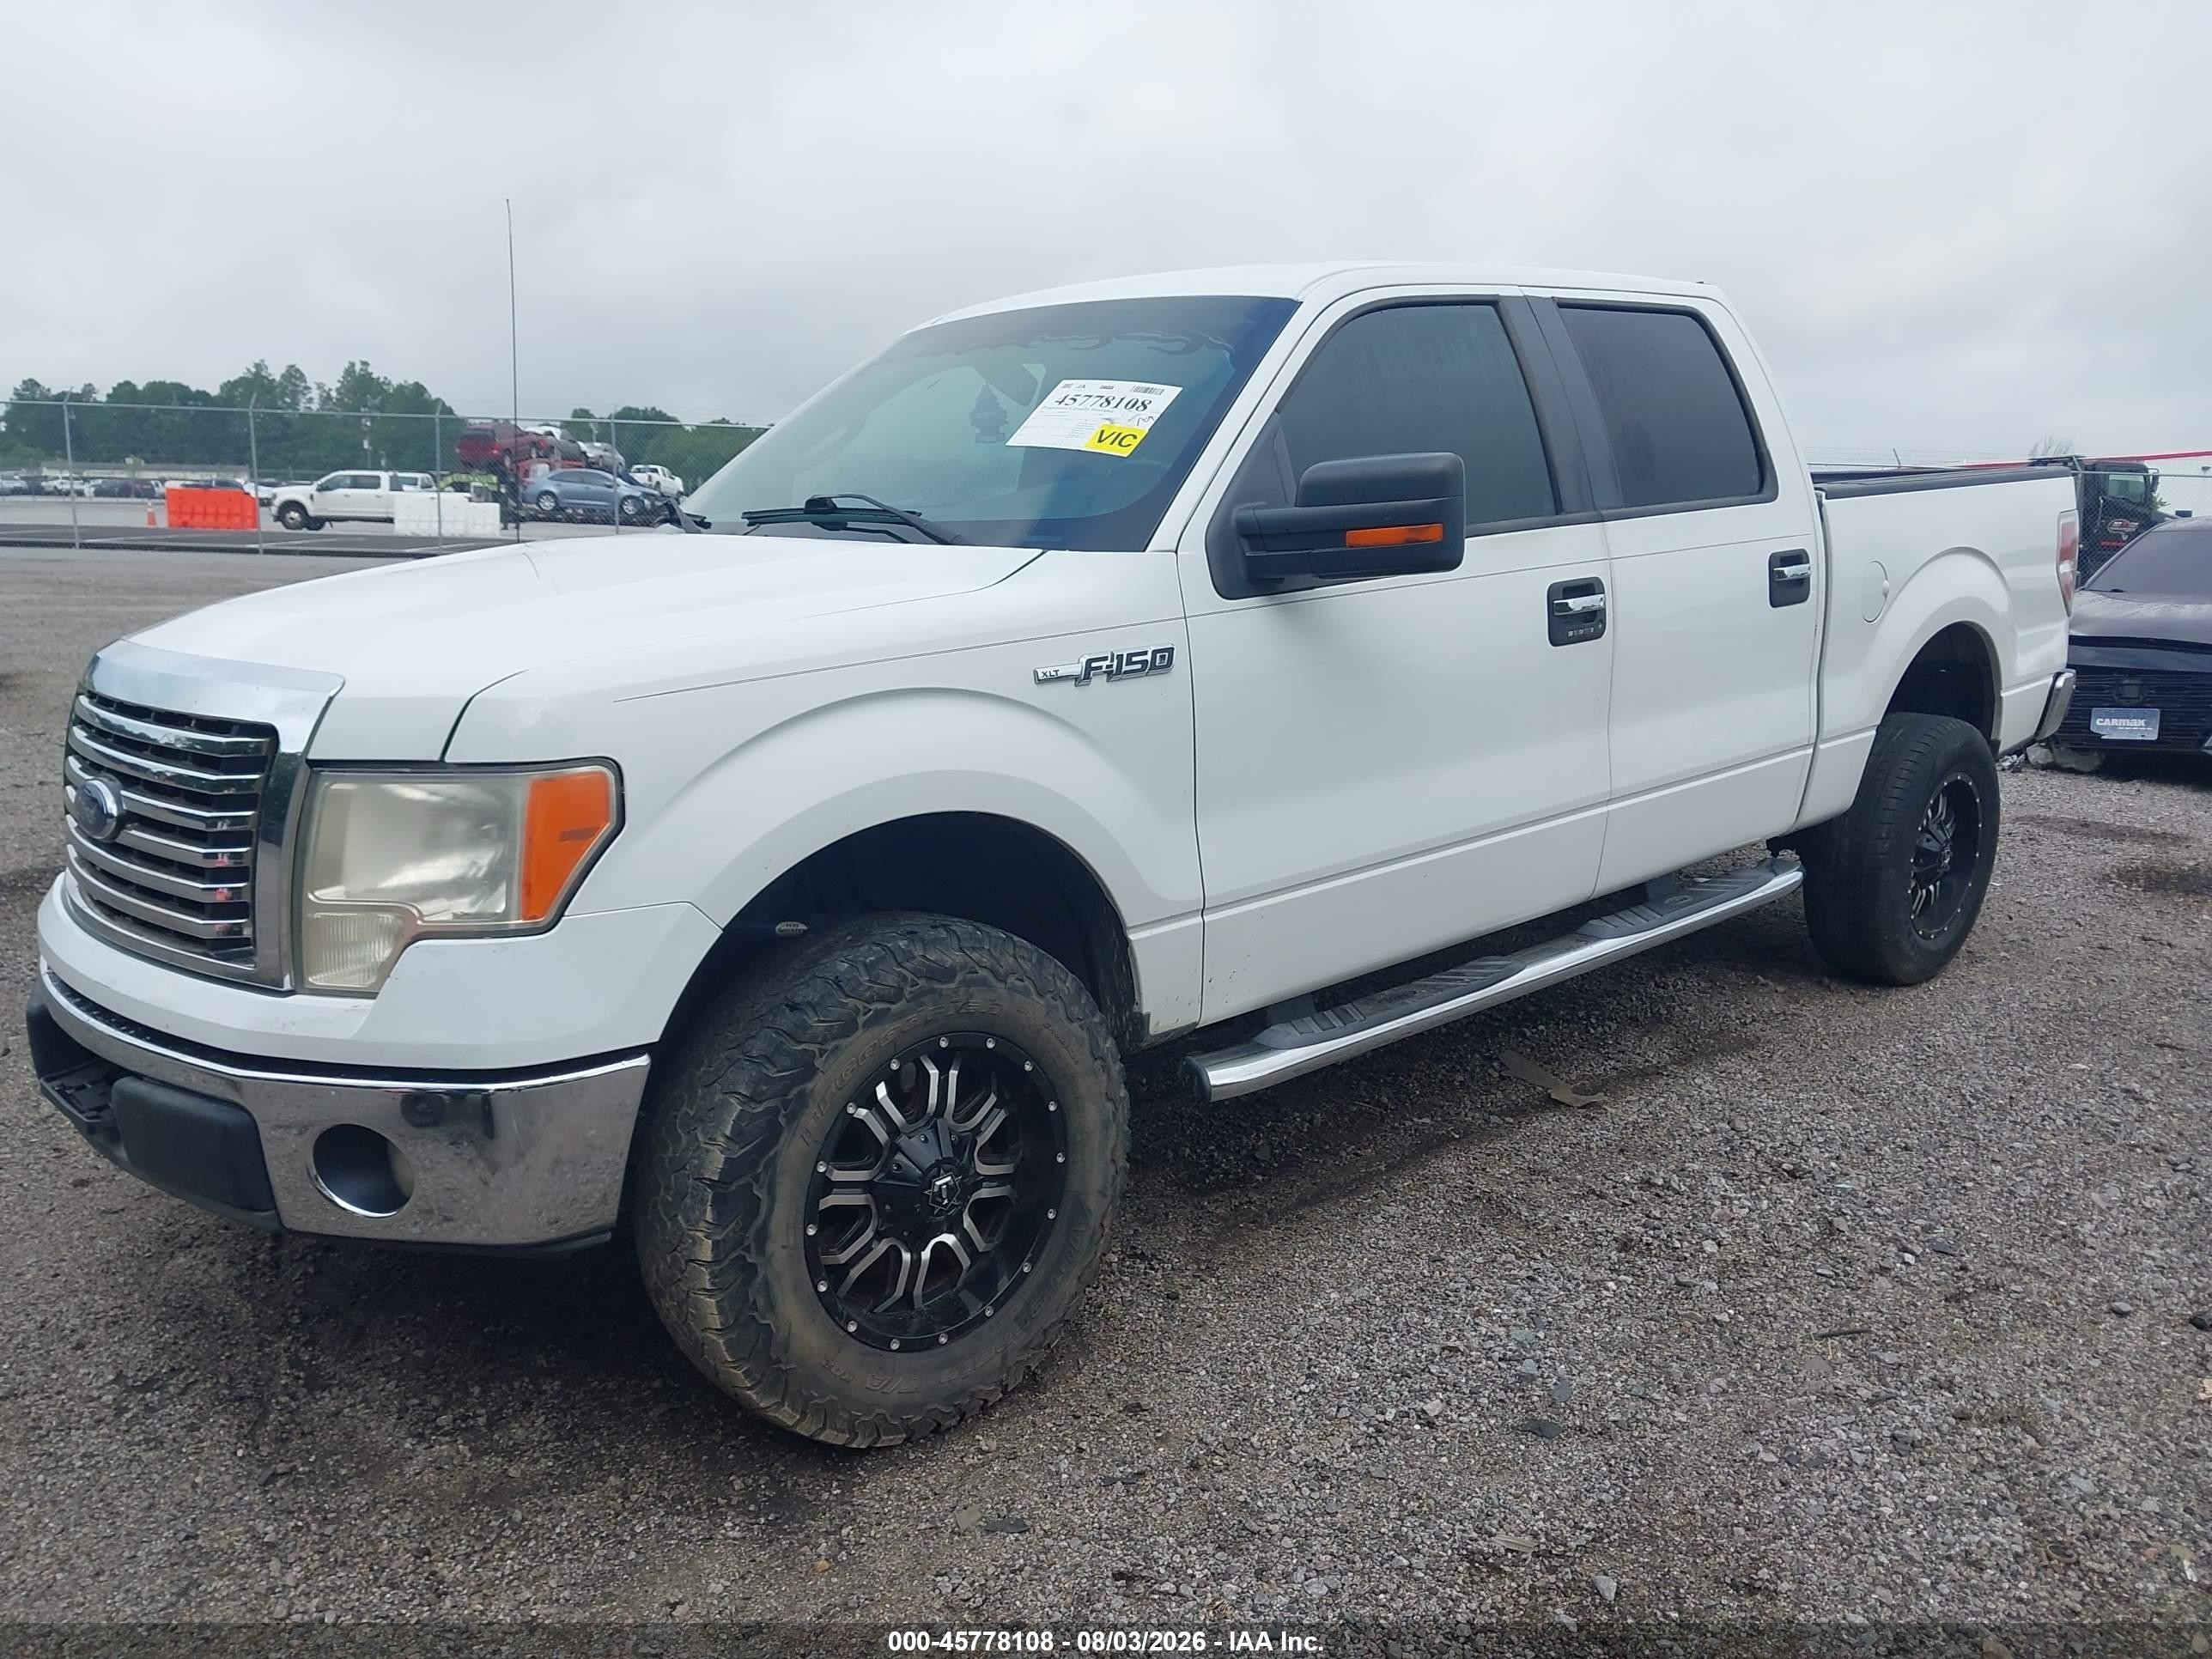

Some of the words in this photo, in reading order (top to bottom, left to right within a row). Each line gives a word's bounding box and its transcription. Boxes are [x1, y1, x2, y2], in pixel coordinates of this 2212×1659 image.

[1054, 393, 1153, 412] 45778108
[1097, 428, 1138, 448] VIC
[1041, 669, 1060, 678] XLT
[1079, 645, 1176, 685] F-150
